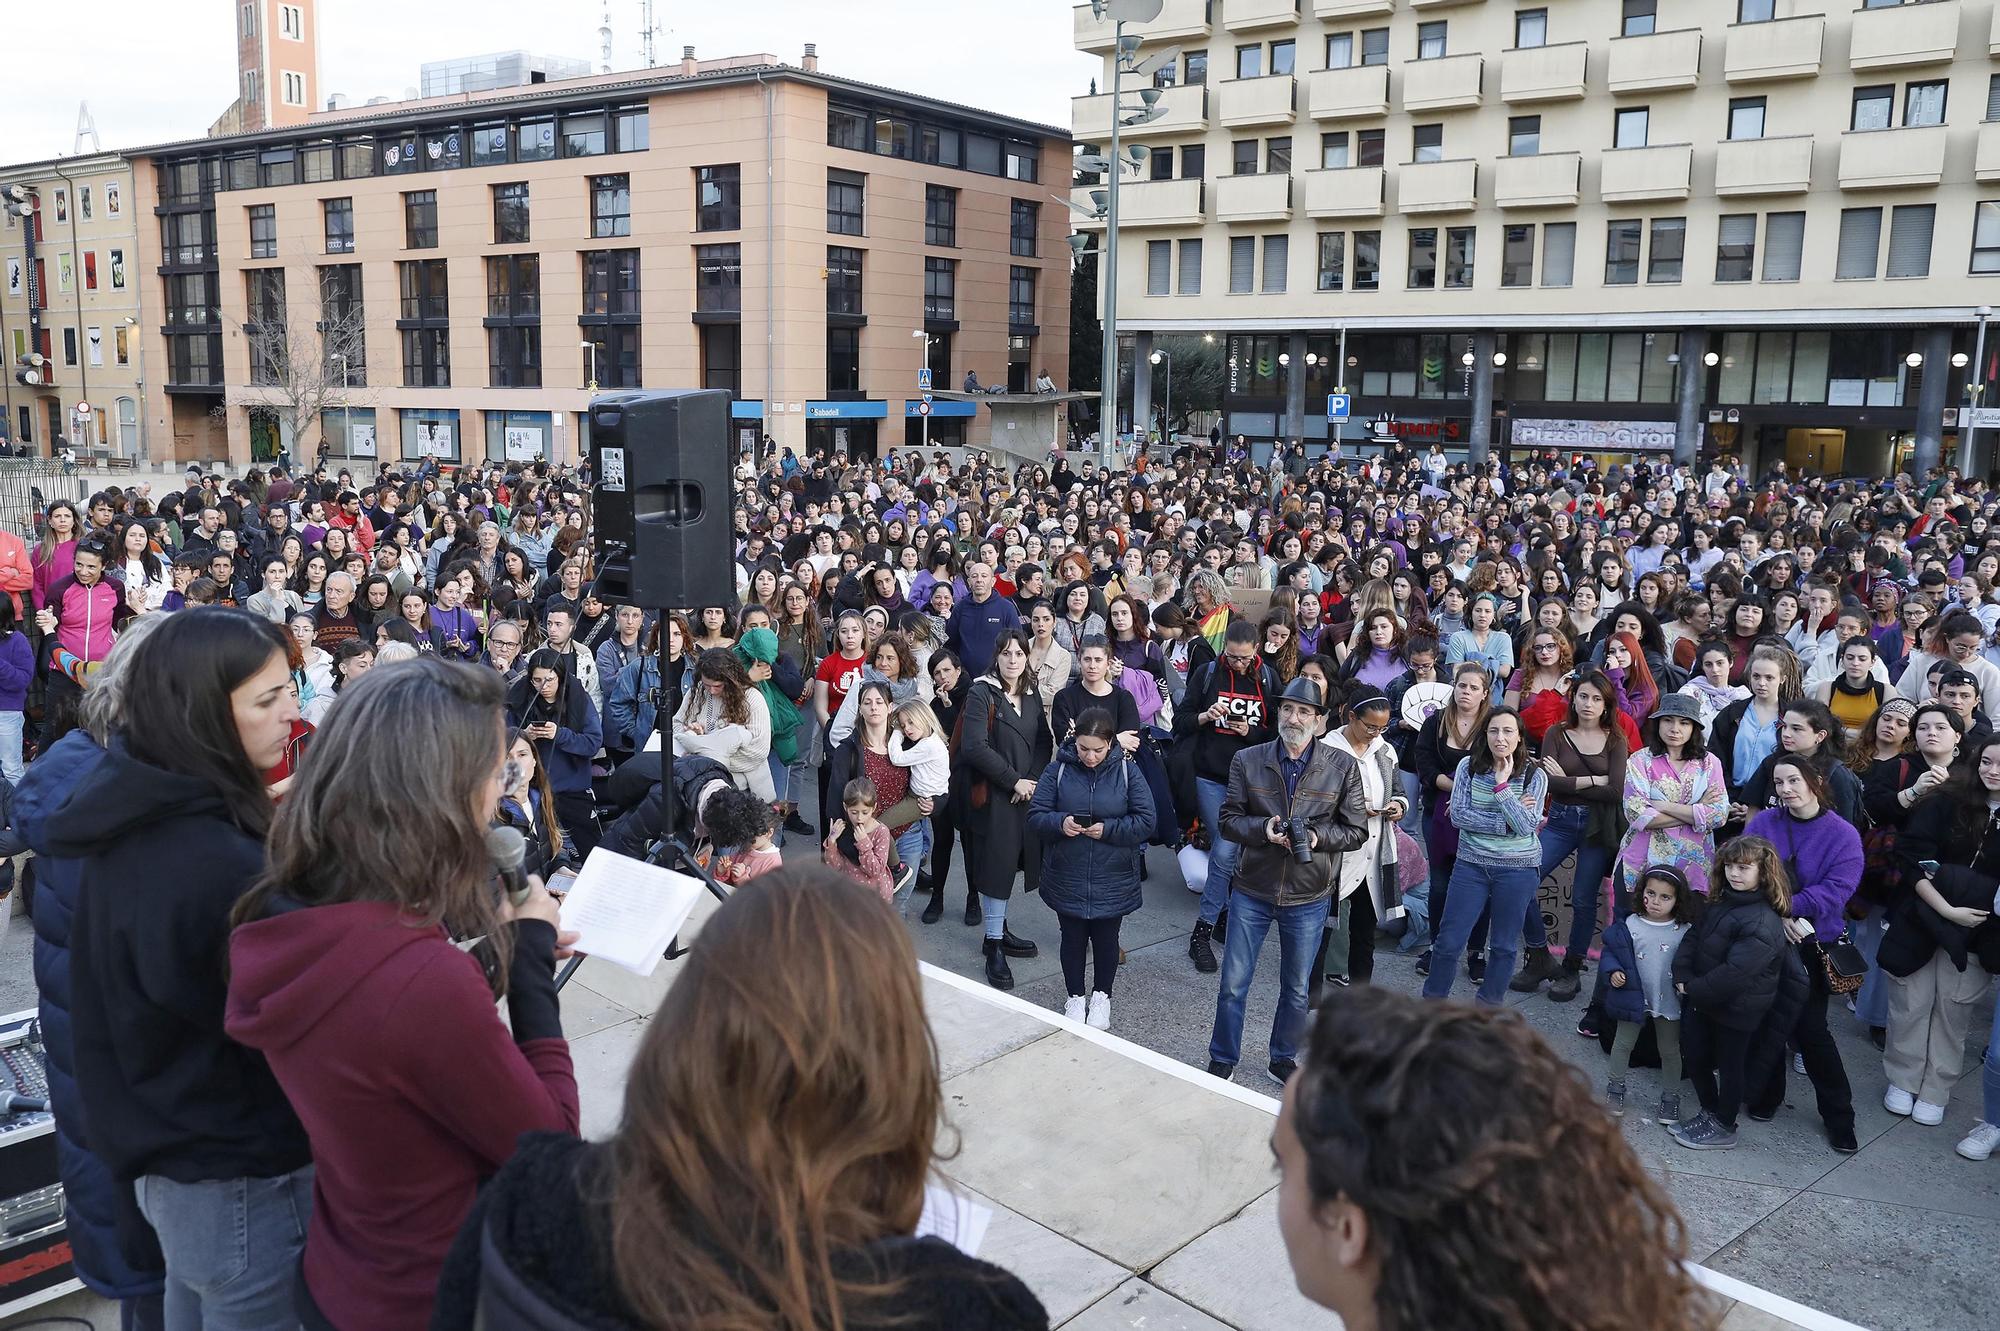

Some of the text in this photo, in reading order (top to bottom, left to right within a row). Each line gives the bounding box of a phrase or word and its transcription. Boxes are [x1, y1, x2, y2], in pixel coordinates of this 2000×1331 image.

[814, 408, 839, 417] Sabadell
[1332, 397, 1345, 414] P
[1521, 426, 1676, 446] Pizzeria Giron
